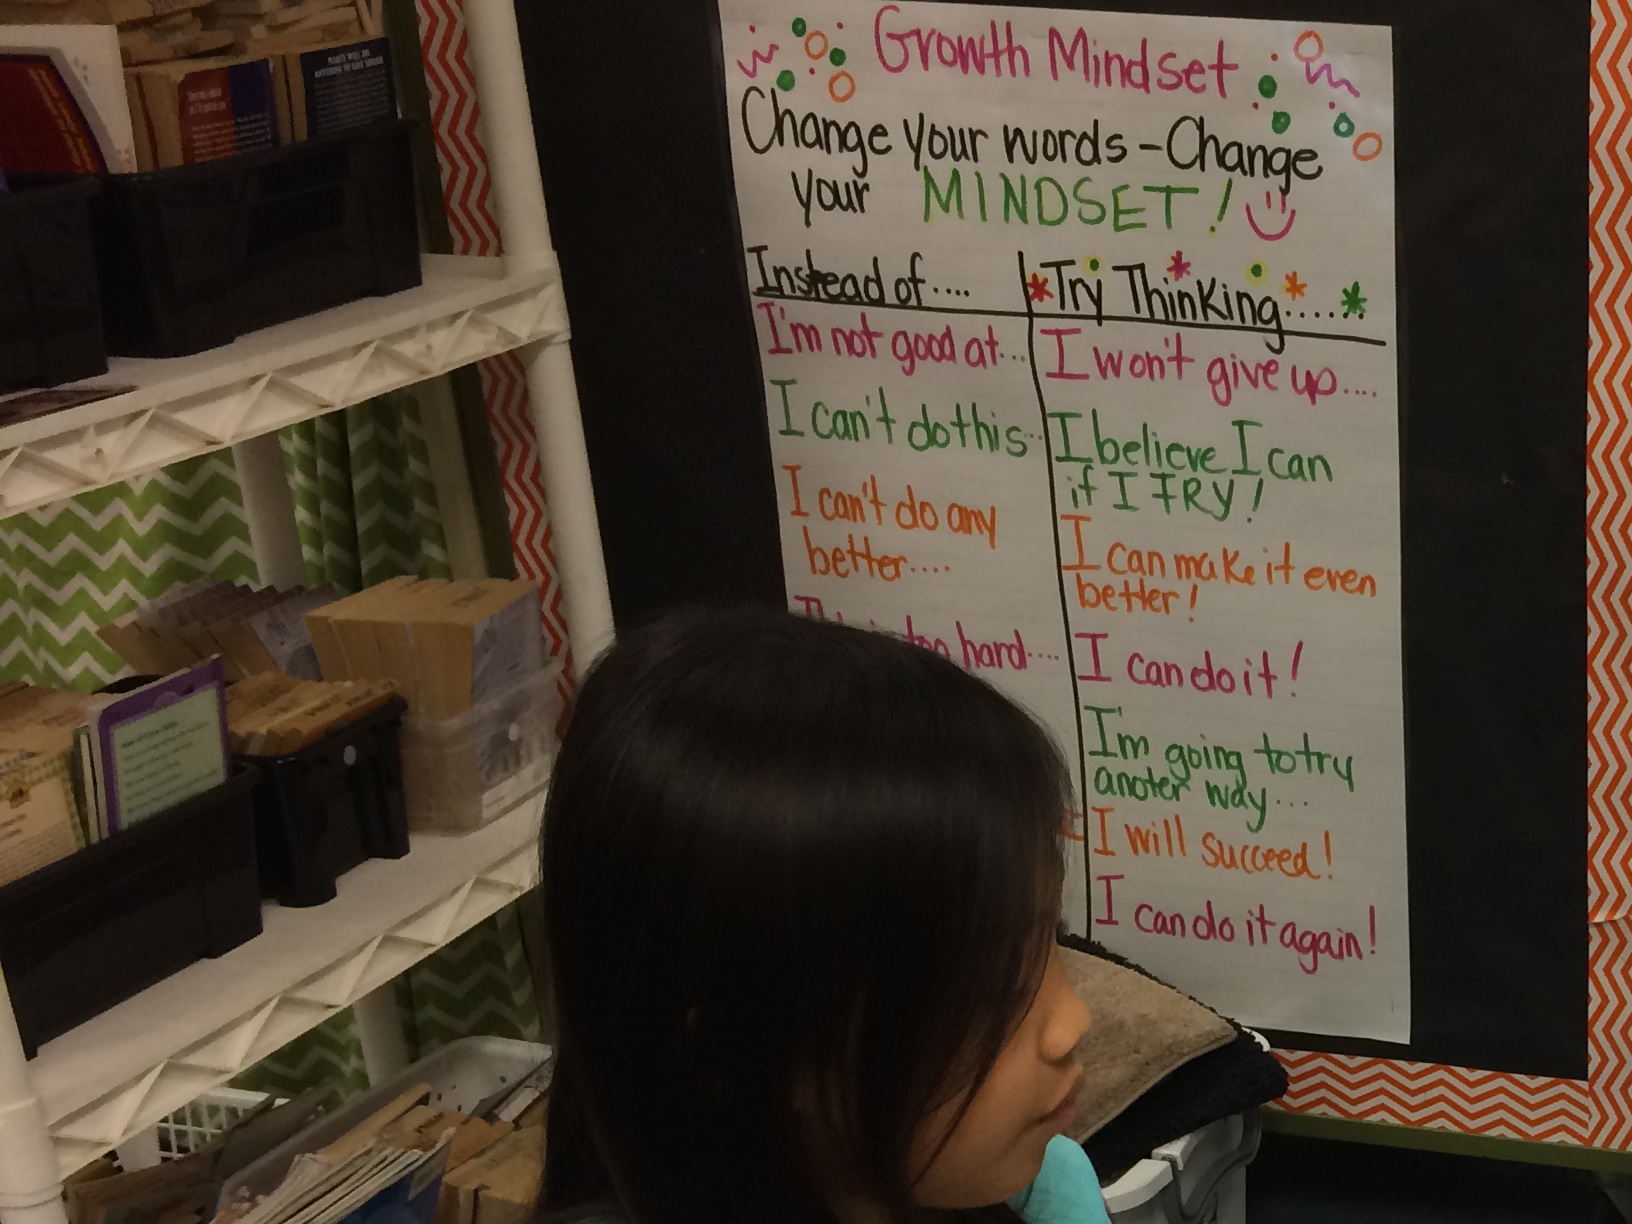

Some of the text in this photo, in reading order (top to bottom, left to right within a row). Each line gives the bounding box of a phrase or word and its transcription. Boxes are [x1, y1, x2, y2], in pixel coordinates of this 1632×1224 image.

[874, 4, 1239, 99] Growth Mindset
[741, 86, 892, 178] Change
[1003, 119, 1128, 167] words
[1167, 115, 1323, 196] Change
[791, 165, 1233, 235] your MINDSET!
[747, 245, 885, 305] Instead
[1040, 259, 1103, 326] Try
[756, 301, 822, 355] I'm
[831, 312, 883, 358] not
[892, 325, 957, 376] good
[1039, 328, 1090, 380] I
[1093, 332, 1195, 382] won't
[1206, 353, 1280, 407] give
[769, 379, 805, 437] I
[811, 386, 896, 445] can't
[1046, 408, 1333, 482] I believe I can
[782, 465, 996, 550] I can't do any
[1066, 464, 1098, 509] if
[1108, 471, 1139, 512] I
[1060, 514, 1377, 597] I can make it even
[1076, 572, 1199, 623] better!
[1074, 632, 1112, 682] I
[1127, 652, 1183, 689] can
[1190, 650, 1236, 694] do
[1083, 704, 1354, 793] I'm going to try
[1091, 806, 1116, 857] I
[1124, 814, 1186, 857] will
[1095, 874, 1376, 974] I can do it again!
